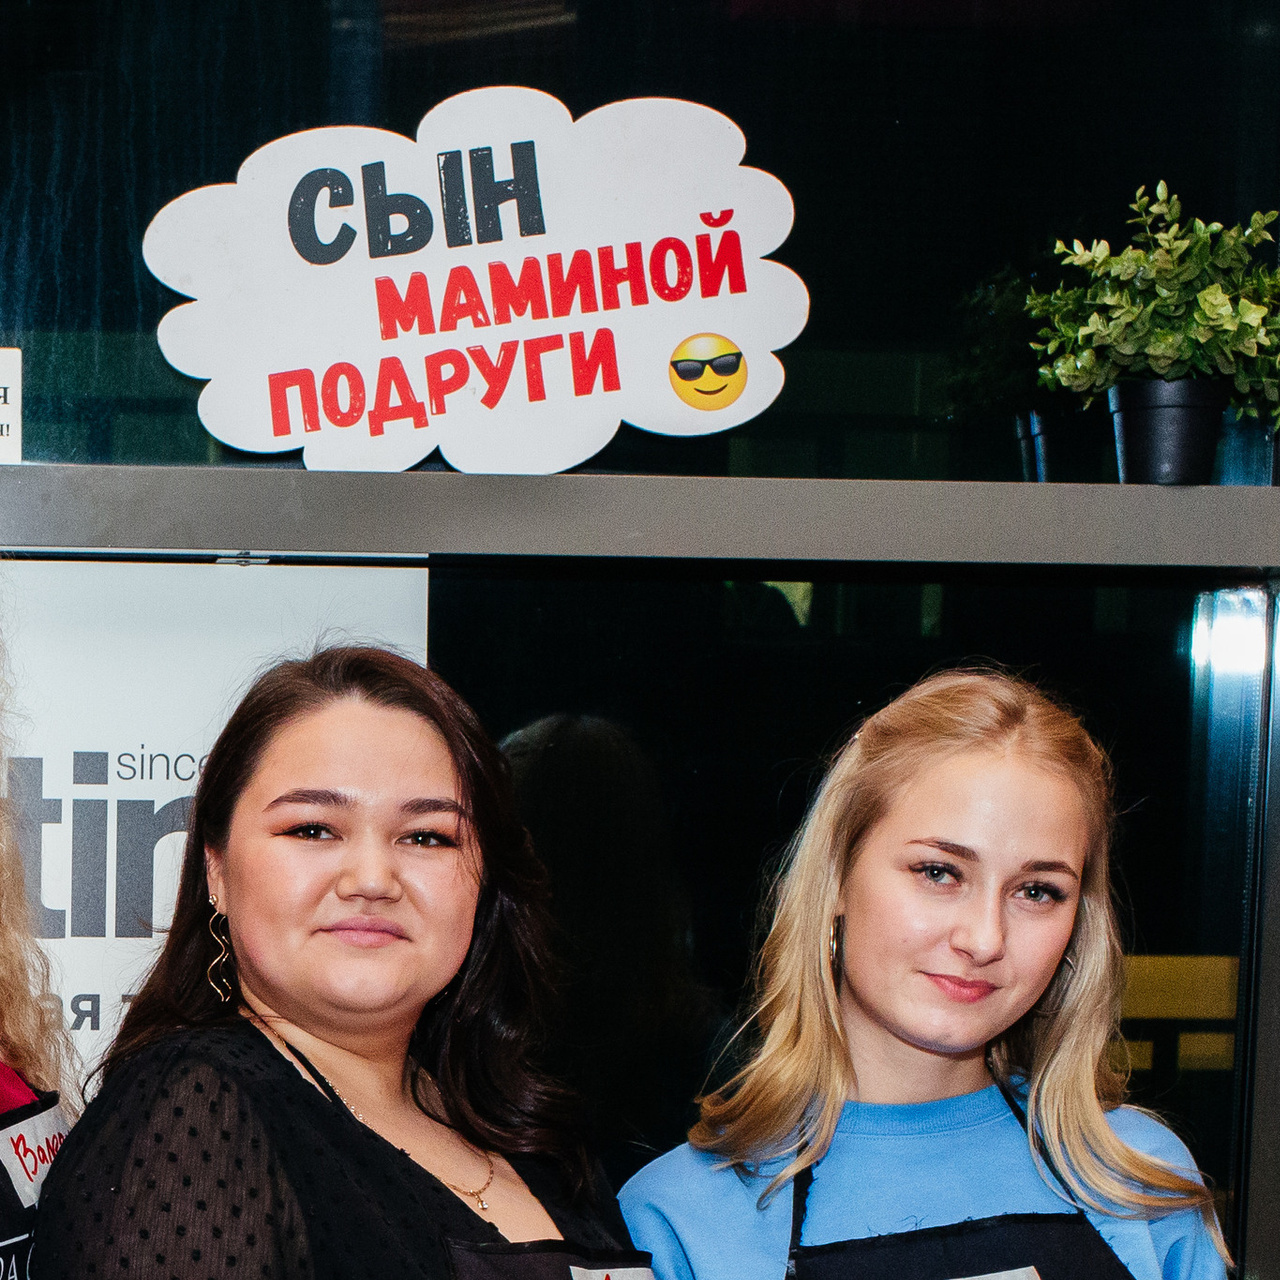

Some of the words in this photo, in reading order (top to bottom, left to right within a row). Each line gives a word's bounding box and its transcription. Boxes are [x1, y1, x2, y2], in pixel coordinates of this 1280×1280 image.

[288, 140, 547, 266] СЫН
[374, 208, 748, 340] МАМИНОЙ
[268, 328, 621, 437] ПОДРУГИ
